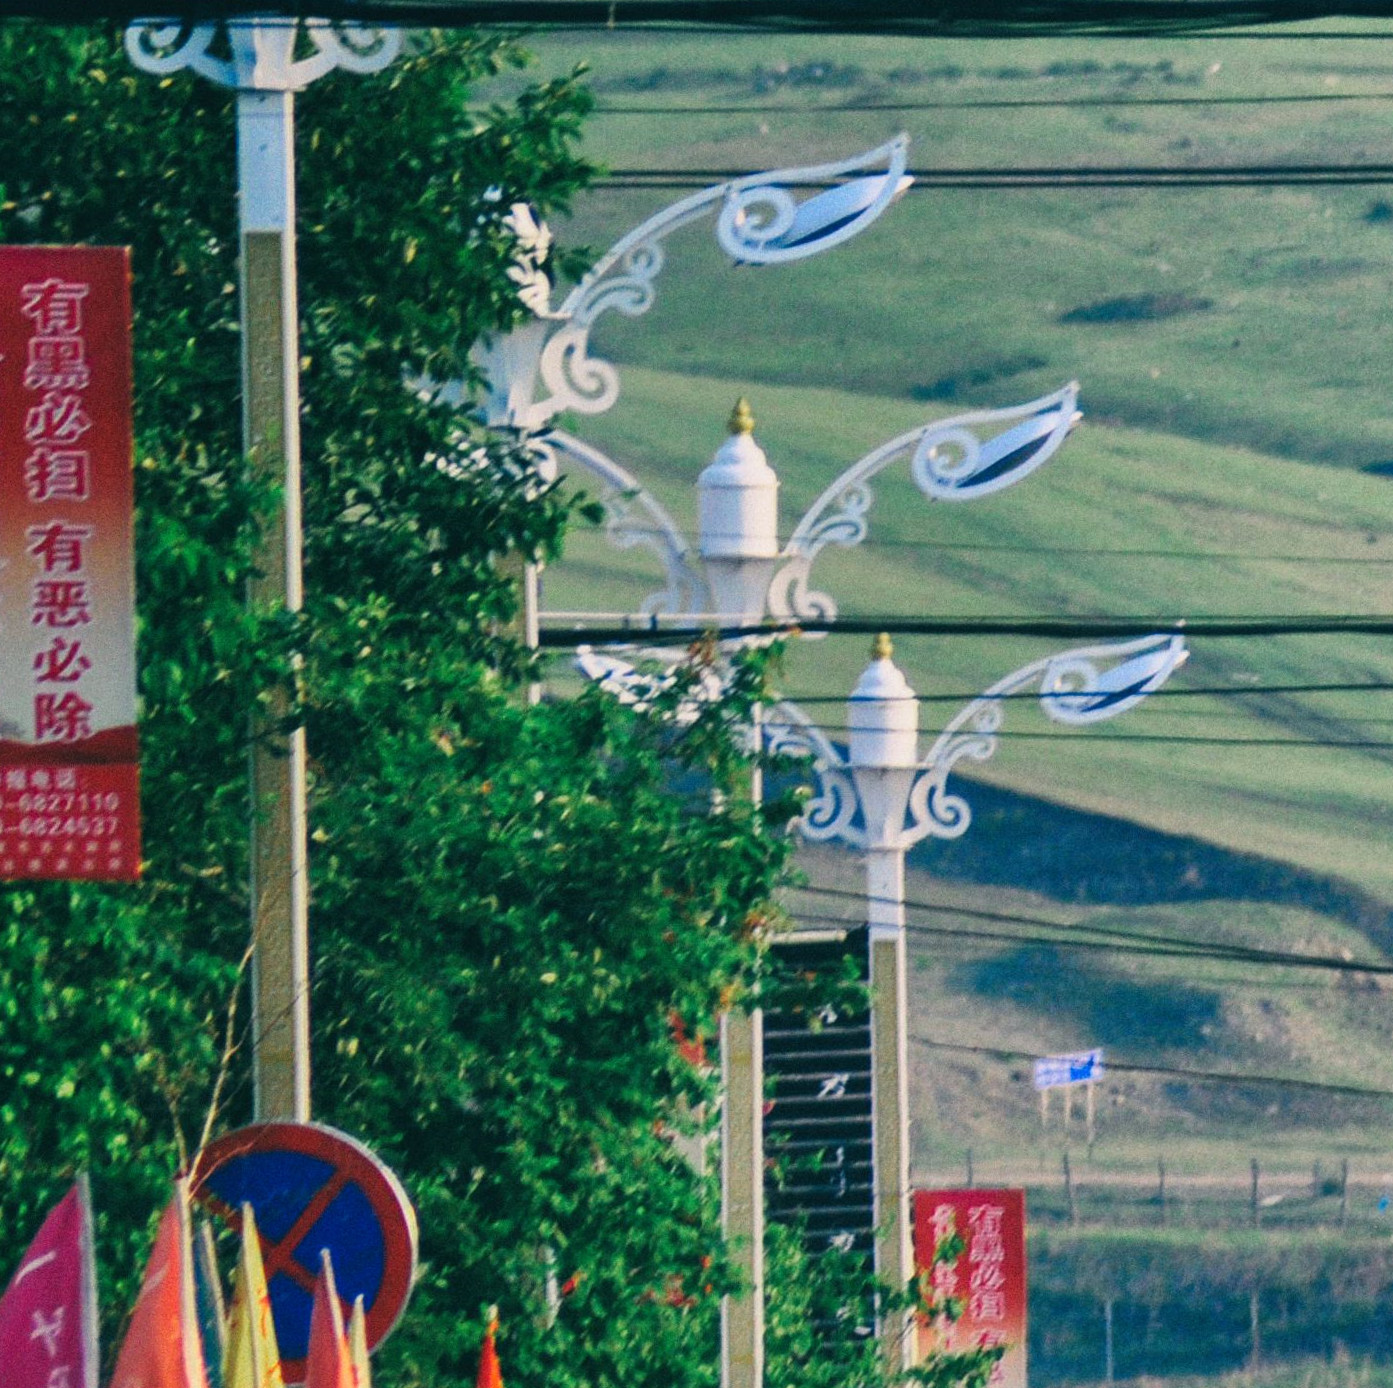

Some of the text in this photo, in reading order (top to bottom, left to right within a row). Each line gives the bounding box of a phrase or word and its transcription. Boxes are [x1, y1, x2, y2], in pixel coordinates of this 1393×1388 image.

[21, 278, 94, 741] 有黑必扫 有恶必除
